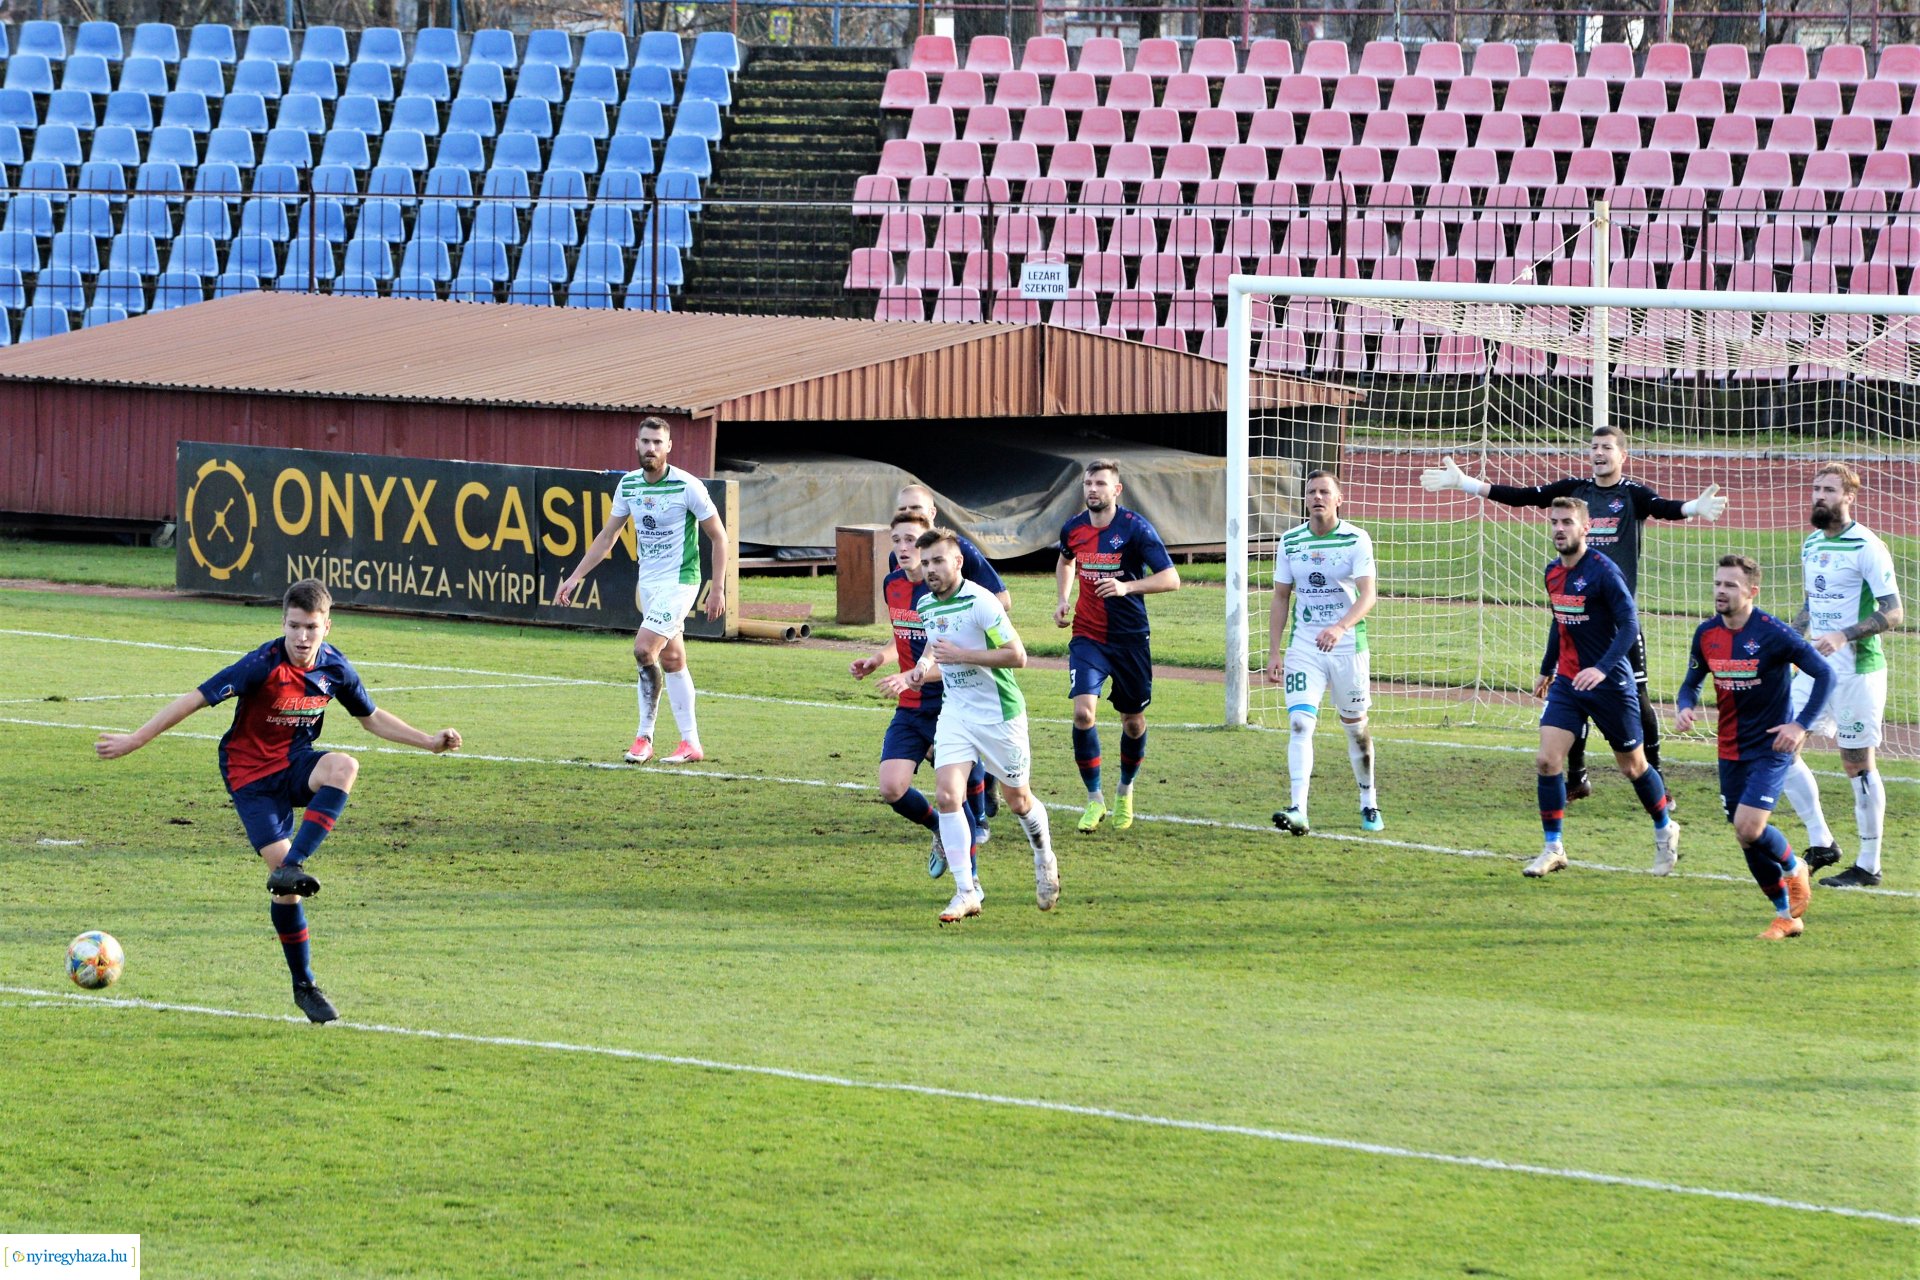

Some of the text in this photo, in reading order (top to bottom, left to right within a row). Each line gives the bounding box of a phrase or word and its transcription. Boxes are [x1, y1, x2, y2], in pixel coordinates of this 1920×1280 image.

[1028, 270, 1061, 281] LEZÁRT
[1024, 283, 1064, 293] SZEKTOR
[273, 467, 638, 561] ONYX CASIN
[1286, 671, 1306, 693] 88
